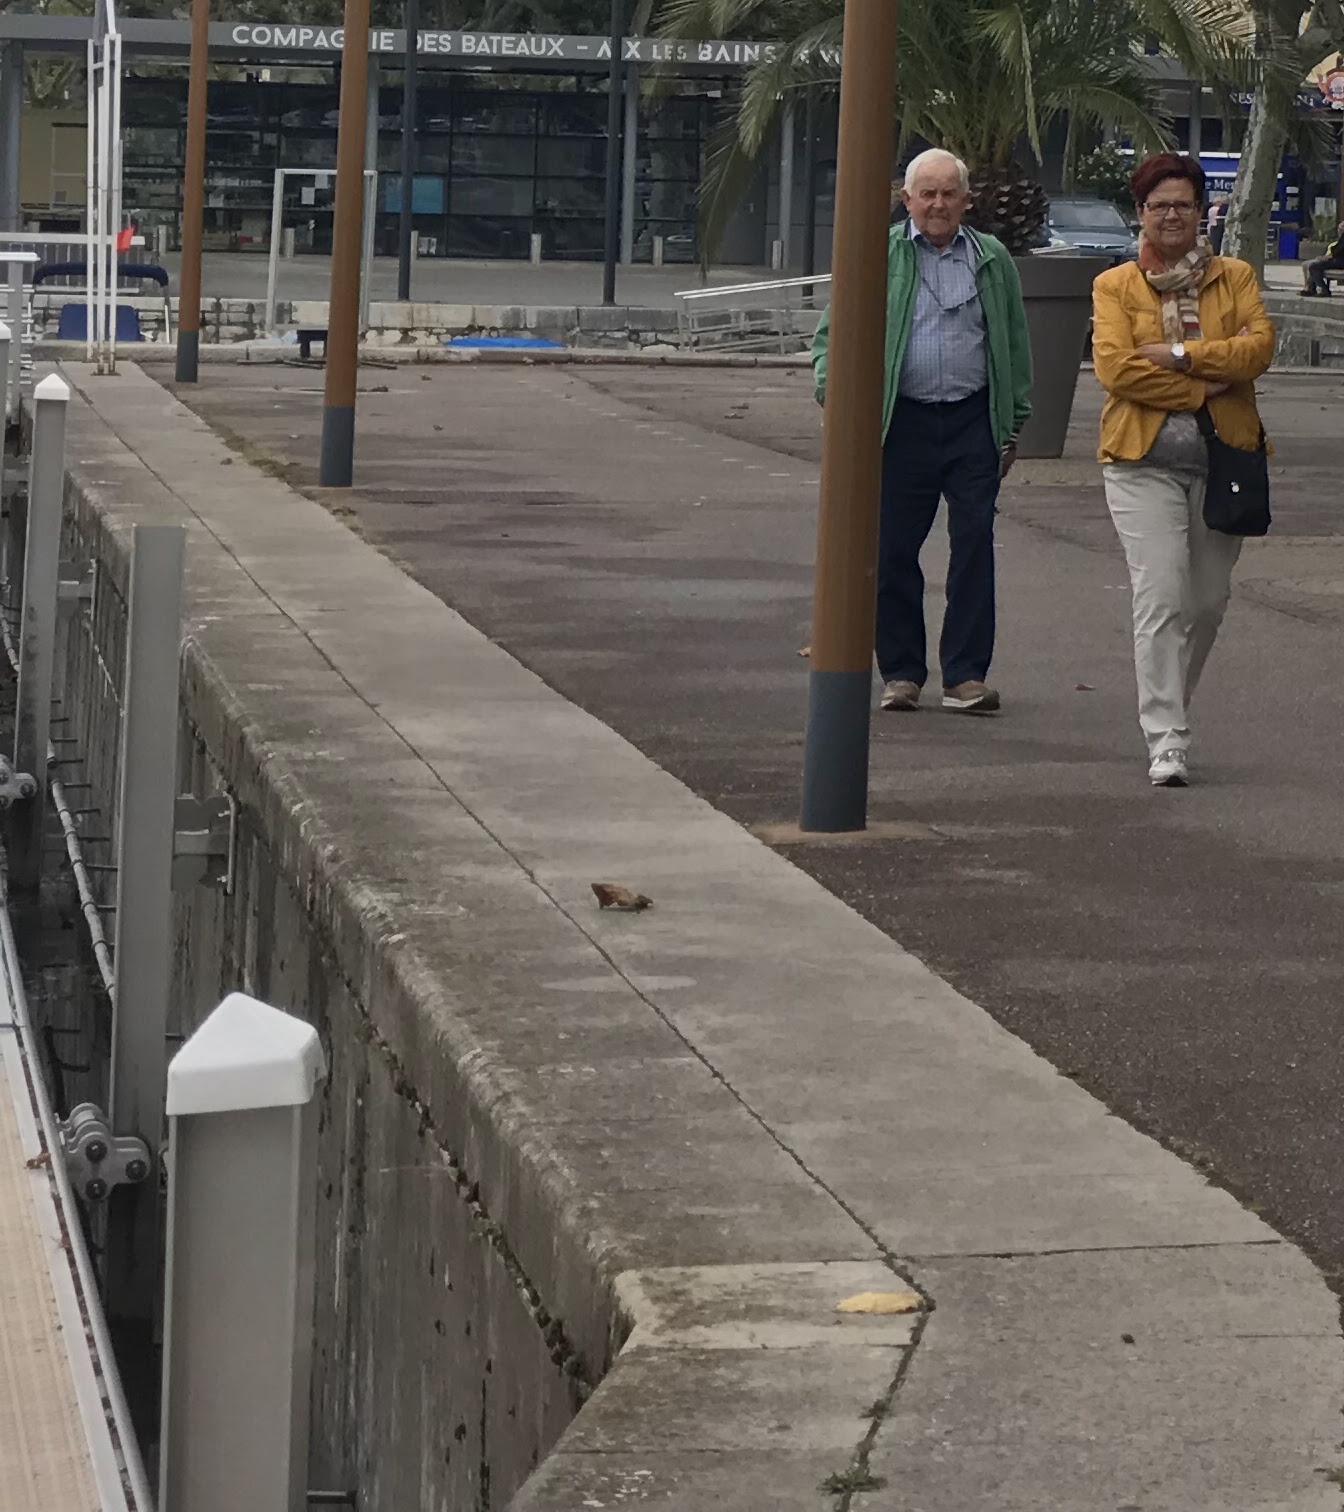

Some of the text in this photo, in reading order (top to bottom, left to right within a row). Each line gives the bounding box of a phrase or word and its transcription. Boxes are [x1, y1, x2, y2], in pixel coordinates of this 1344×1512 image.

[232, 25, 395, 51] COMPAGIE
[461, 35, 565, 58] BATEAUX
[596, 40, 641, 59] AX
[651, 44, 687, 60] LES
[697, 43, 777, 64] BAINS
